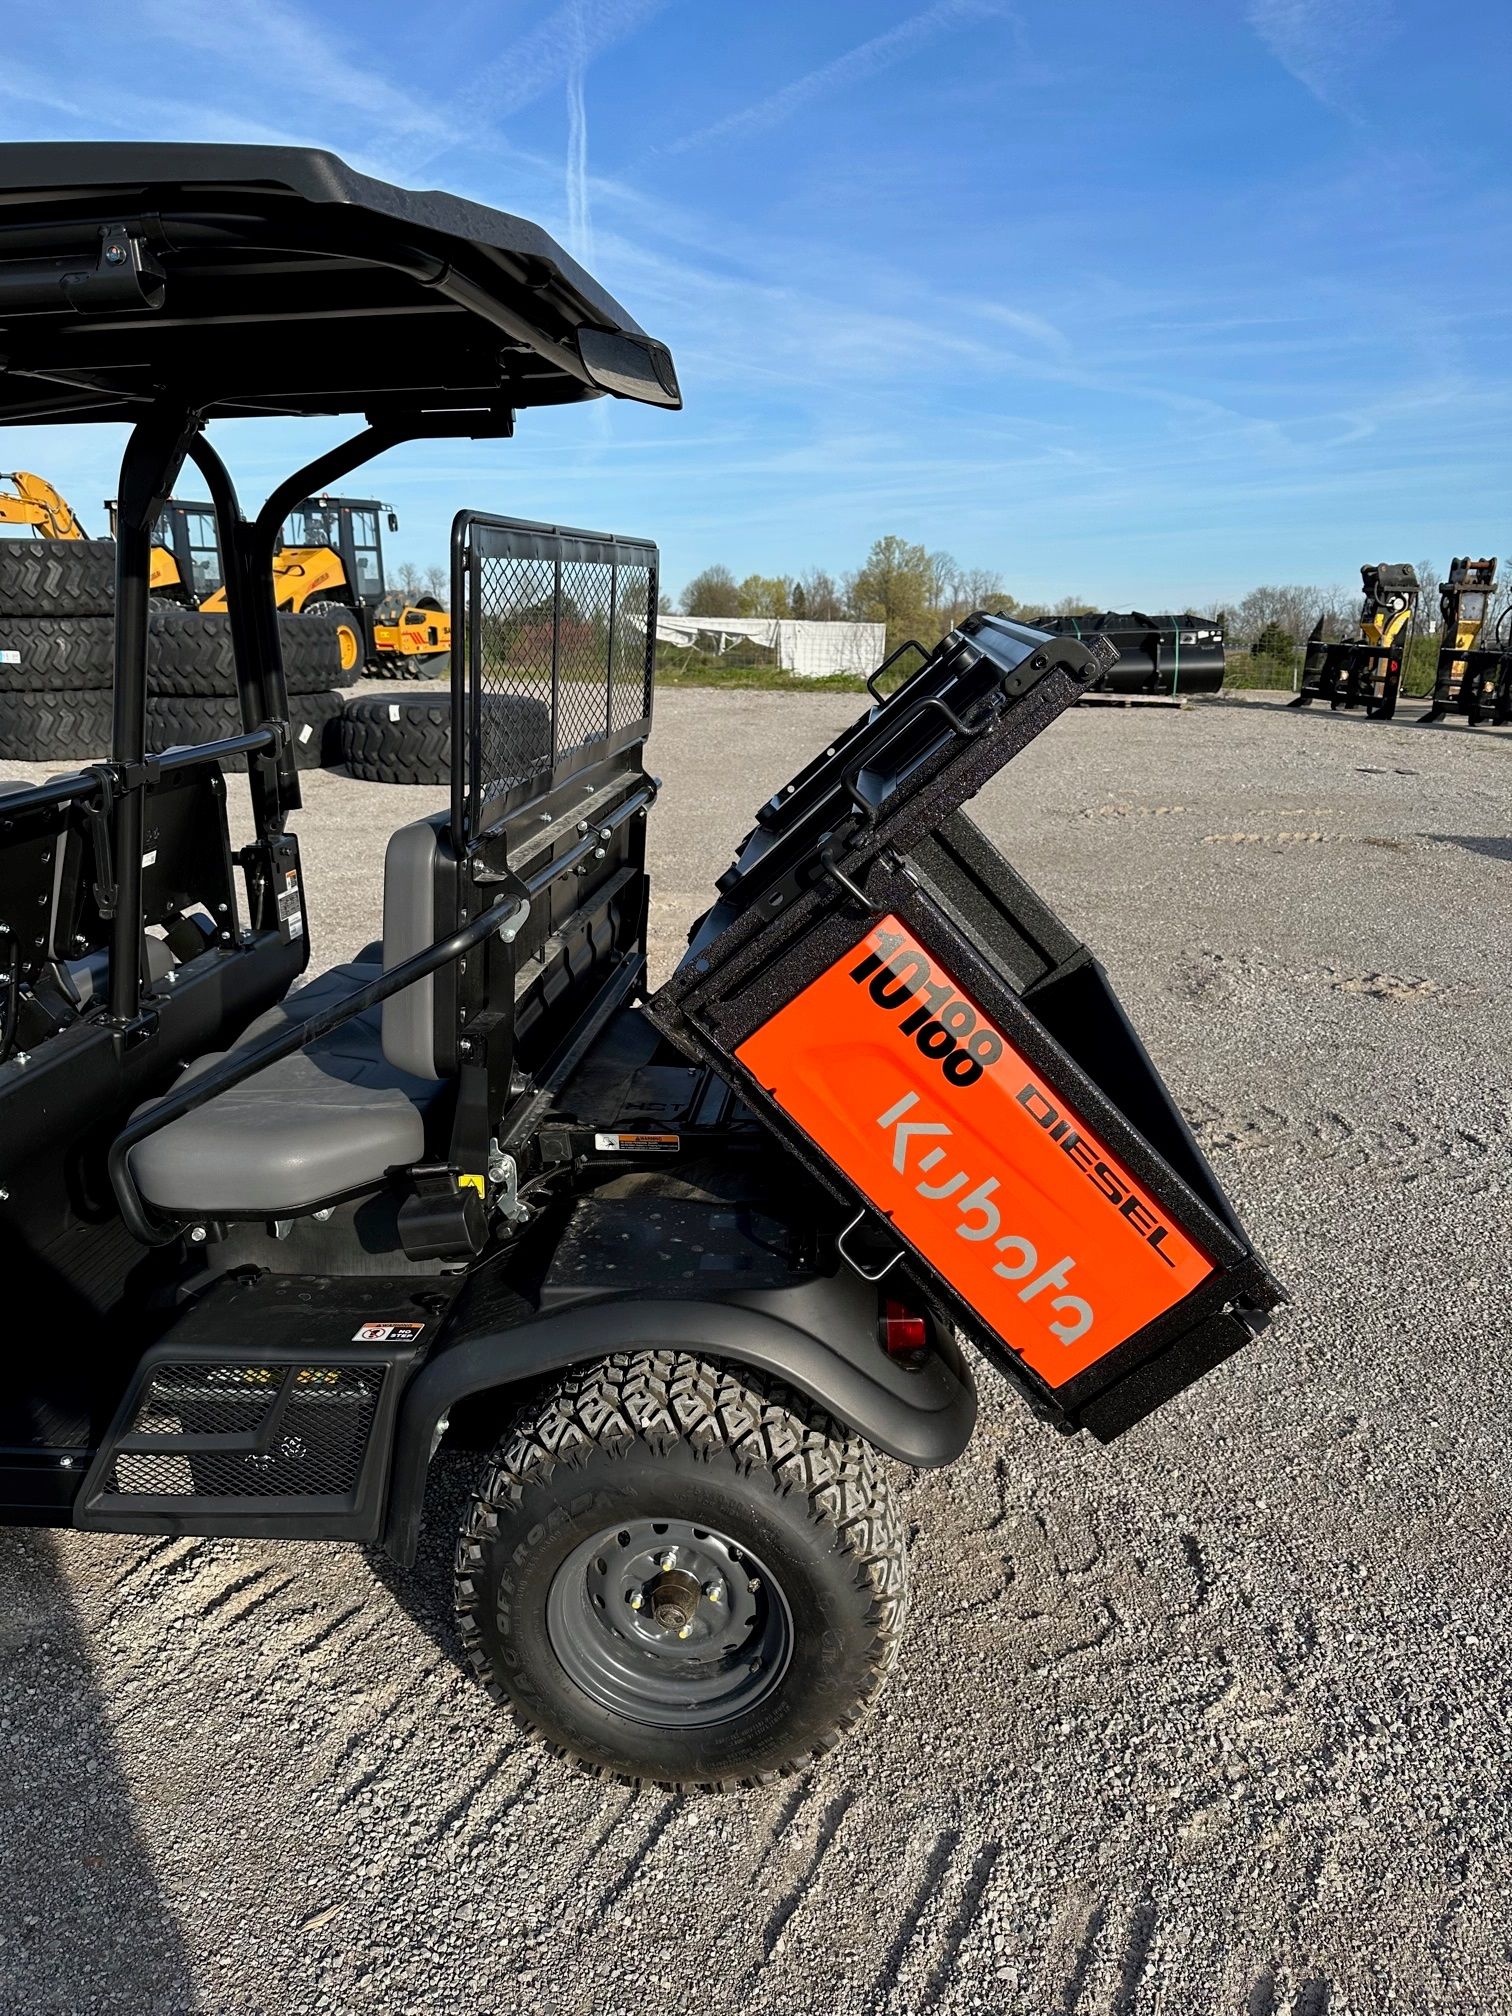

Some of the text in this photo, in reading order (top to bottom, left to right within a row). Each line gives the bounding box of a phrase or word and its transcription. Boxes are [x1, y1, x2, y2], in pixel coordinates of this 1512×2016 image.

[876, 1090, 1094, 1346] Kubota
[1016, 1083, 1175, 1267] DIESEL
[495, 1567, 517, 1635] OFF
[510, 1490, 594, 1571] ROAD
